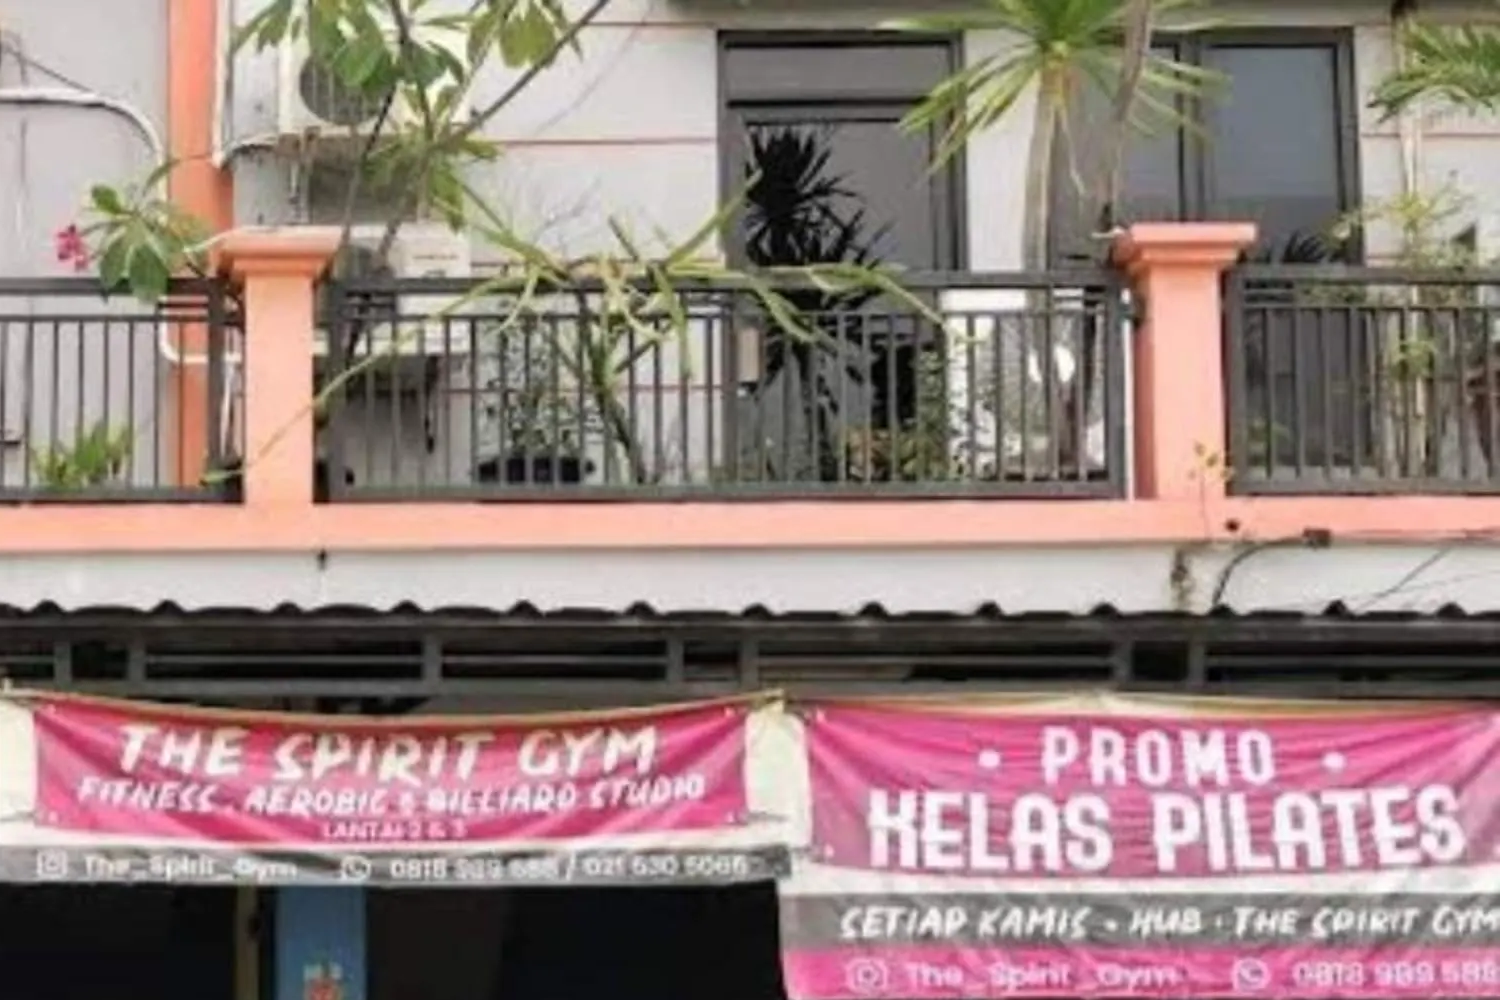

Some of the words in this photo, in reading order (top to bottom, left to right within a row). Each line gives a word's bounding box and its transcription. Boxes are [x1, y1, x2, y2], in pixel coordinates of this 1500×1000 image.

[119, 724, 250, 776] THE
[273, 731, 496, 787] SPIRIT
[518, 726, 659, 777] GYM
[1041, 725, 1275, 787] PROMO
[245, 786, 389, 819] AEROBIC
[428, 783, 576, 816] BILLIARD
[589, 773, 706, 810] STUDIO
[867, 788, 1114, 872] KELAS
[1152, 784, 1466, 872] PILATES
[840, 906, 968, 939] SETIAP
[977, 907, 1092, 939] KAMIS
[1129, 907, 1202, 936] HUB
[1232, 906, 1299, 937] THE
[1311, 907, 1420, 938] SPIRIT
[1432, 906, 1500, 936] GYM
